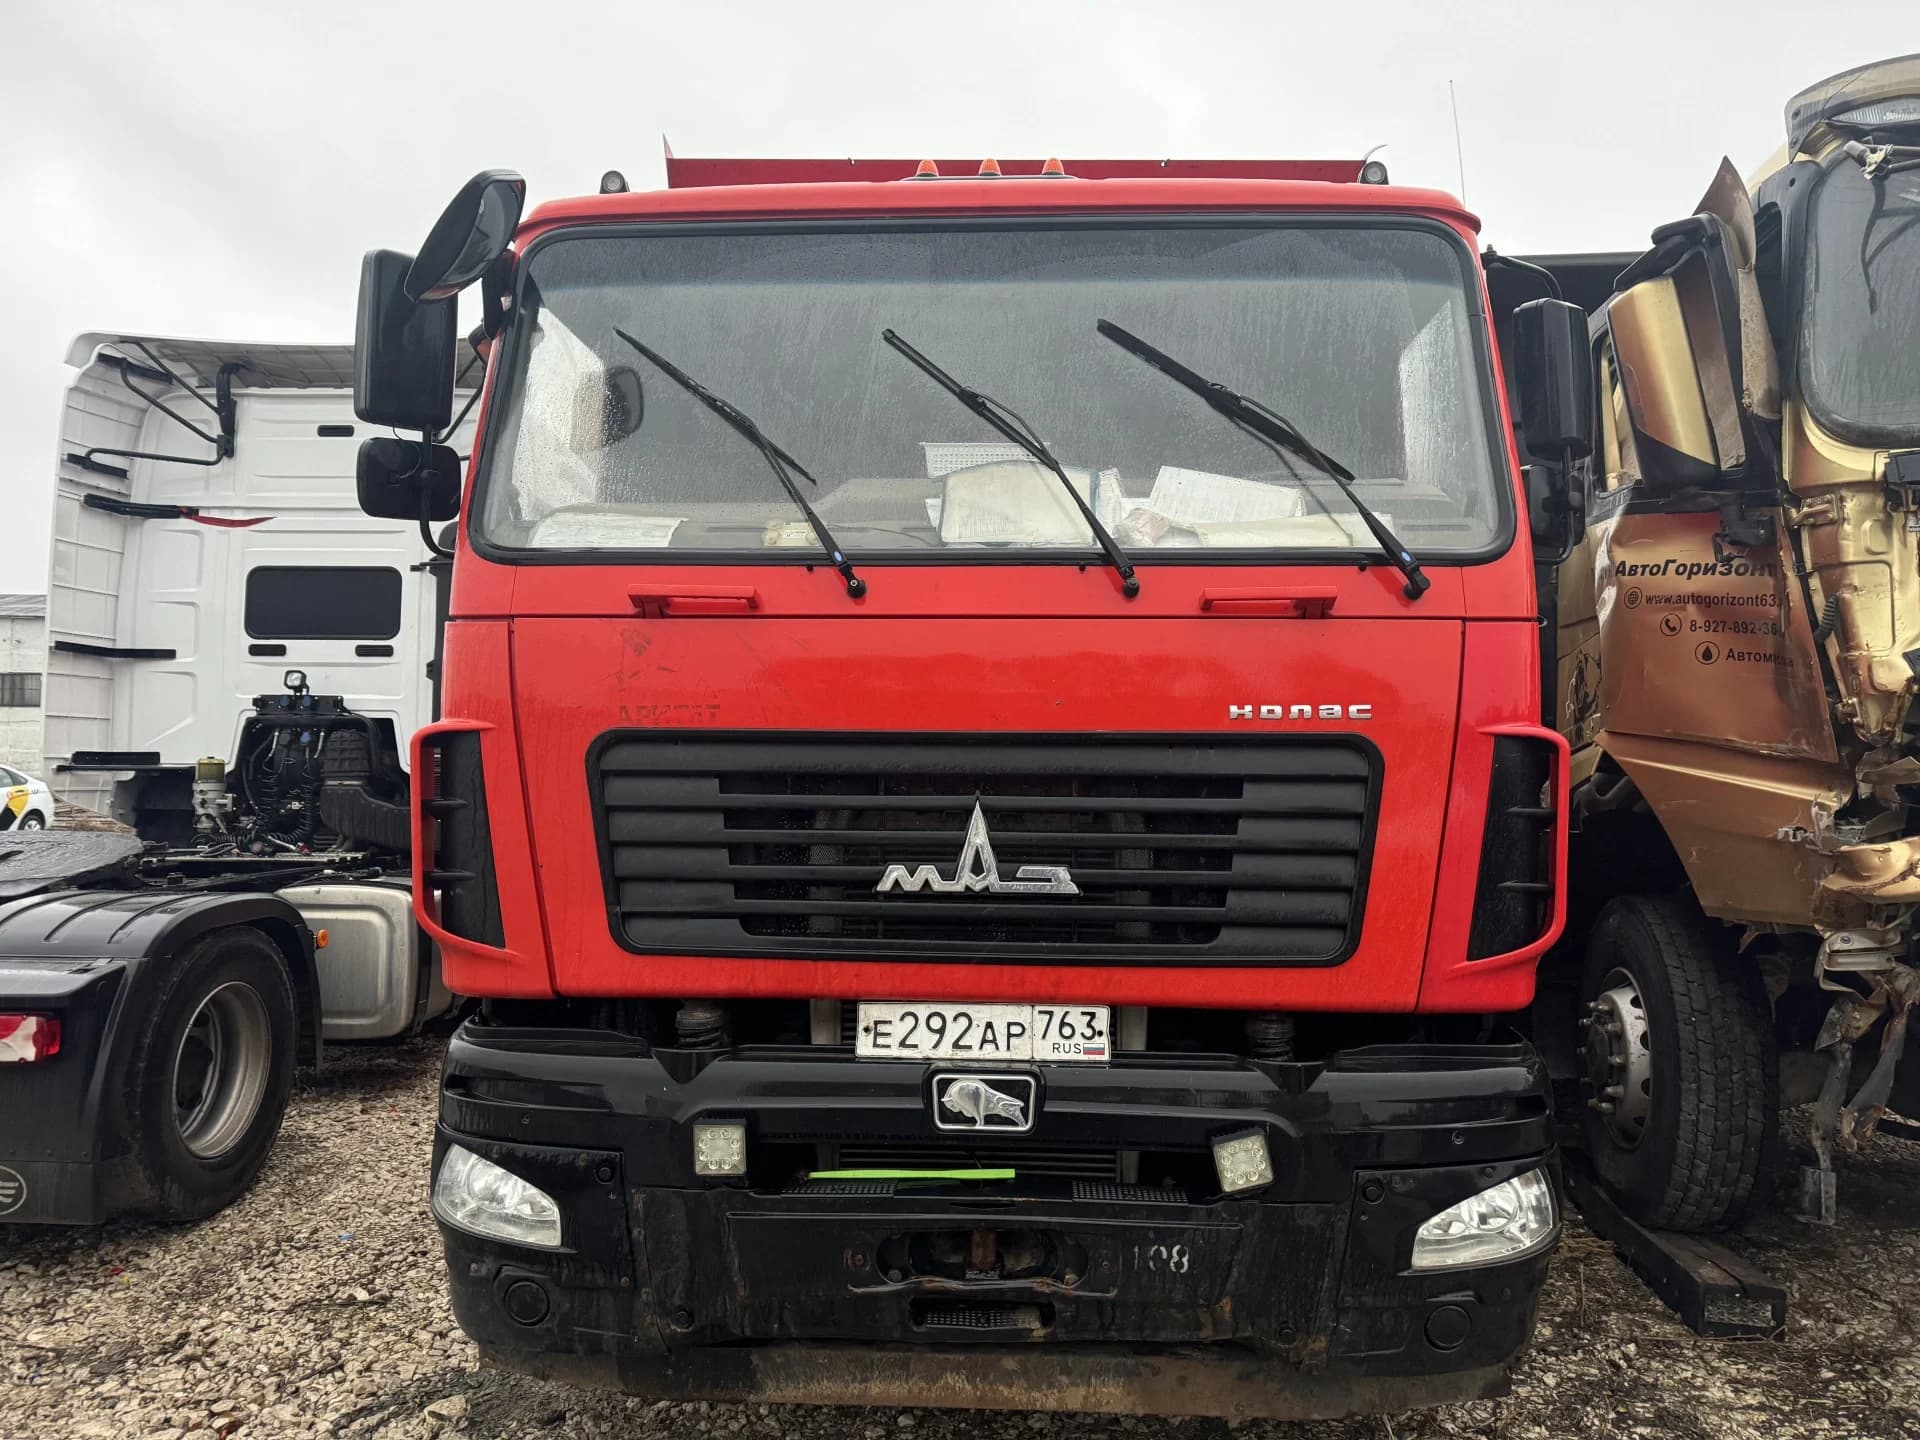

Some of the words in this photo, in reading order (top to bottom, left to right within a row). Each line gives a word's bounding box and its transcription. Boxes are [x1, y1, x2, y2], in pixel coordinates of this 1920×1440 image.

[1614, 558, 1775, 581] АвтоГоризонт
[1689, 619, 1782, 636] 8-927-892-36
[1037, 1009, 1098, 1041] 763
[1052, 1042, 1082, 1054] RUS
